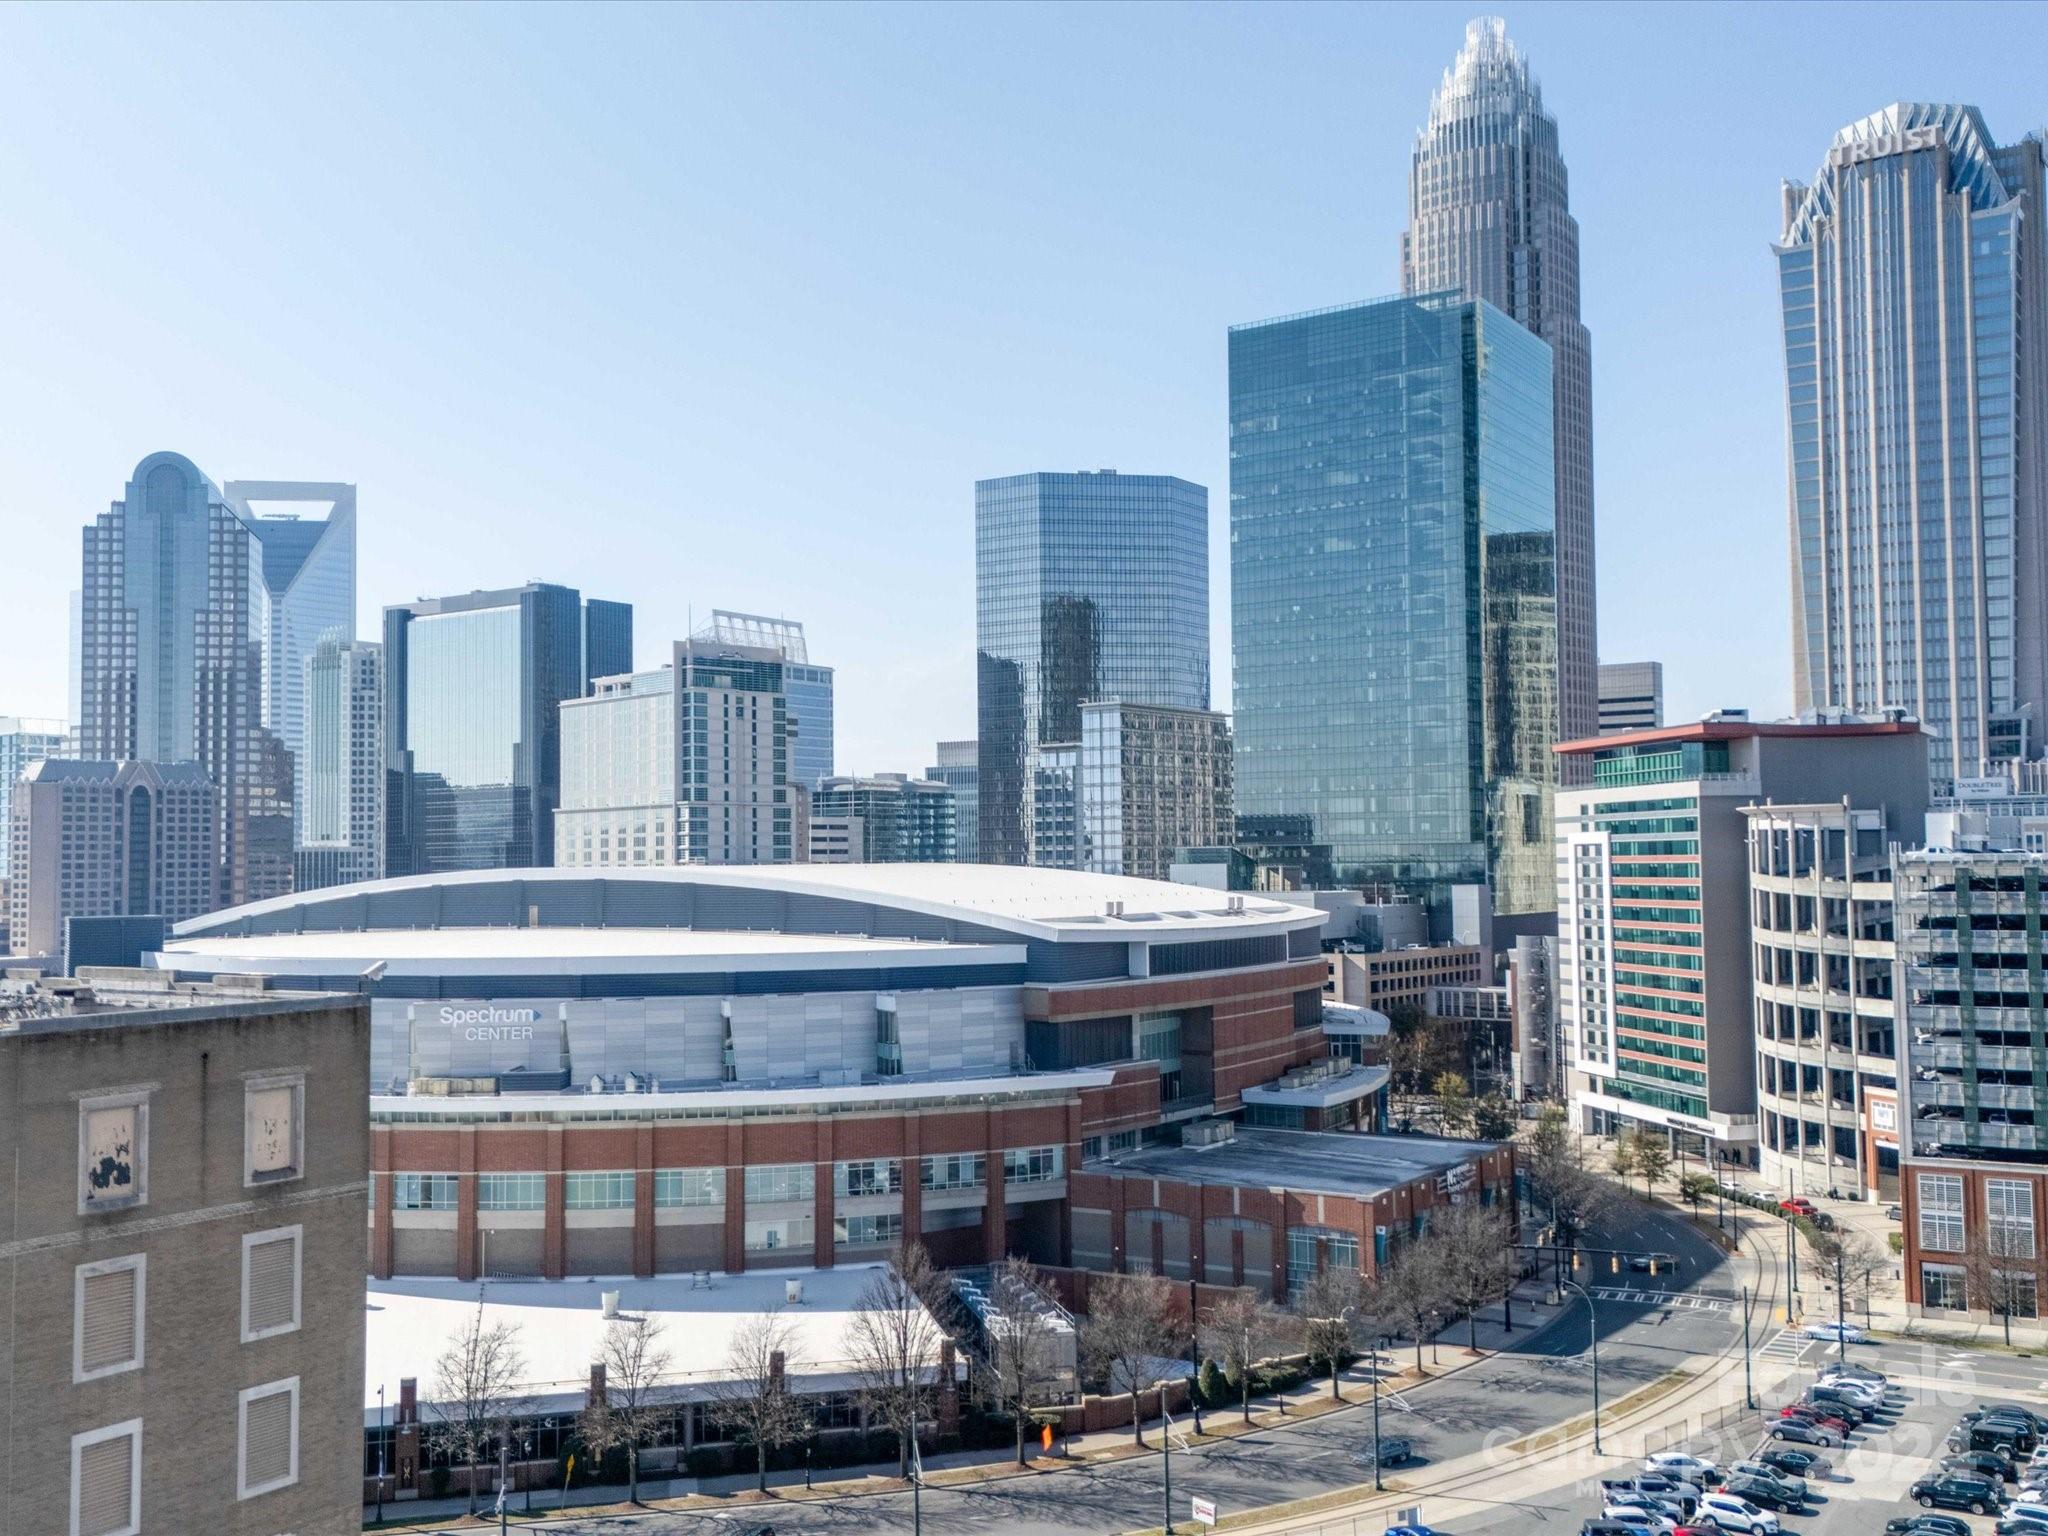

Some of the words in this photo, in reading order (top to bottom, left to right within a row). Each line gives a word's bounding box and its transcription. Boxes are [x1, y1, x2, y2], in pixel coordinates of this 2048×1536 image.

[1830, 124, 1942, 166] TRUIST
[440, 1006, 534, 1028] Spectrum
[465, 1026, 533, 1041] CENTER
